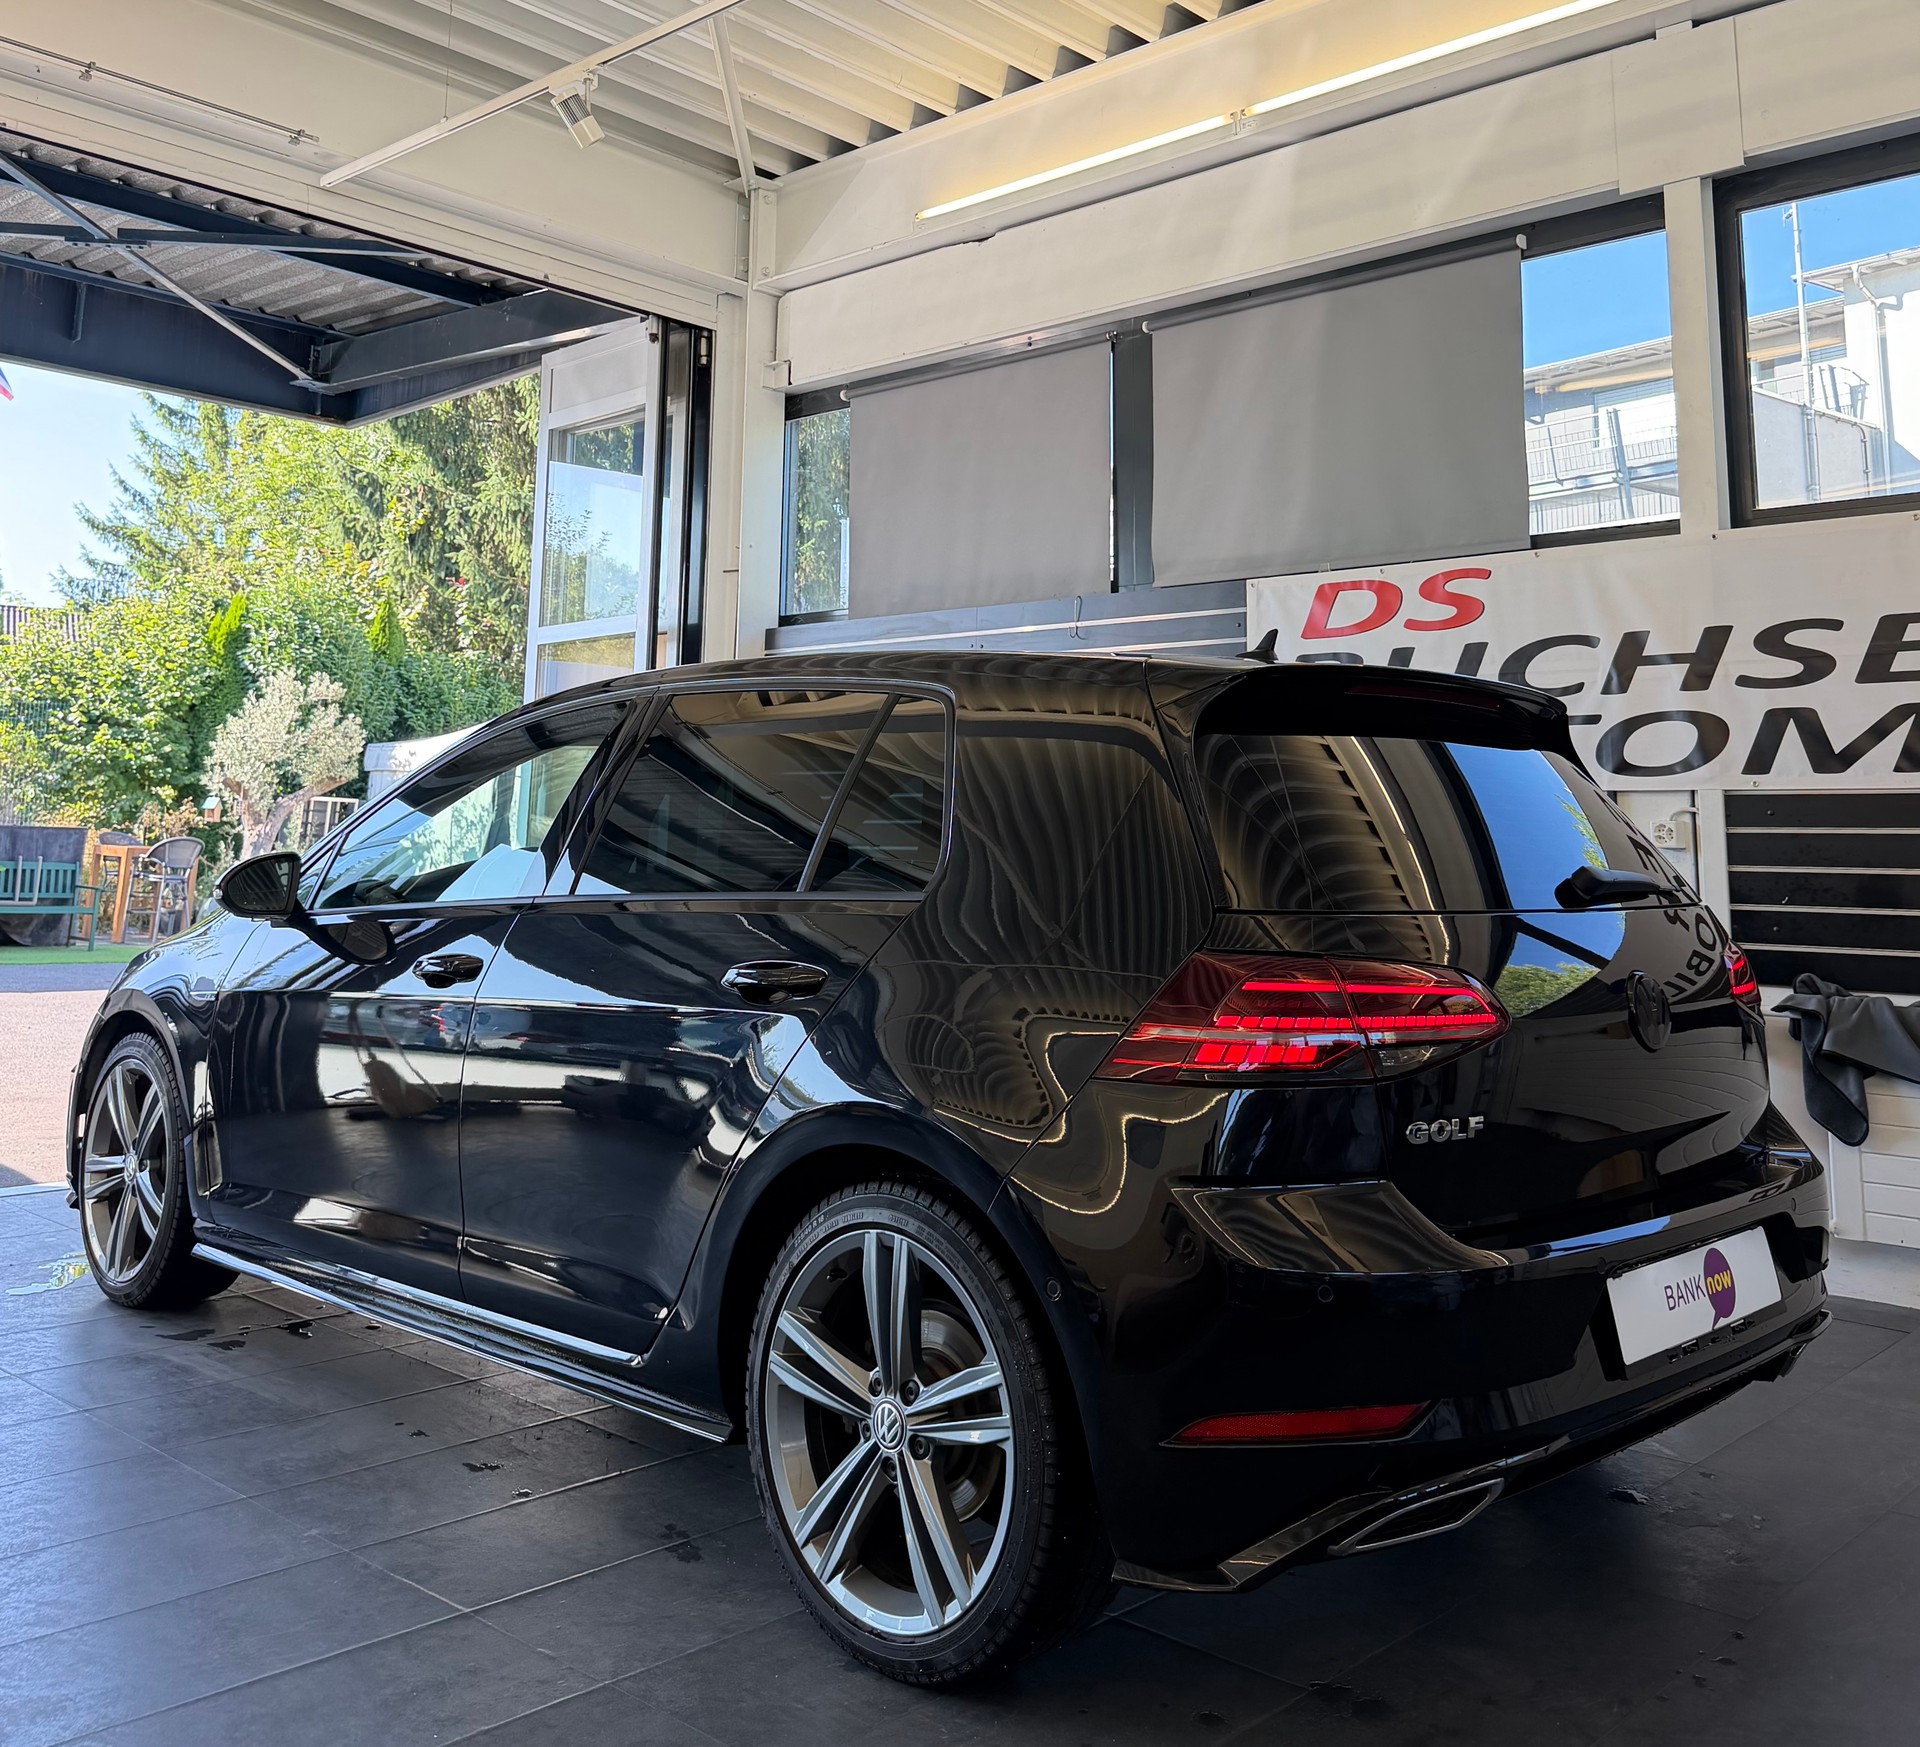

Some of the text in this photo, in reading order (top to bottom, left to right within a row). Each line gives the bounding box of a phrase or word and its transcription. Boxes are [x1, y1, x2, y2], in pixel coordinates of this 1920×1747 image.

[1301, 568, 1491, 639] DS
[1296, 612, 1920, 697] CHSE
[1568, 703, 1920, 777] OM
[1405, 1116, 1484, 1145] GOLF
[1664, 1269, 1732, 1311] BANK now
